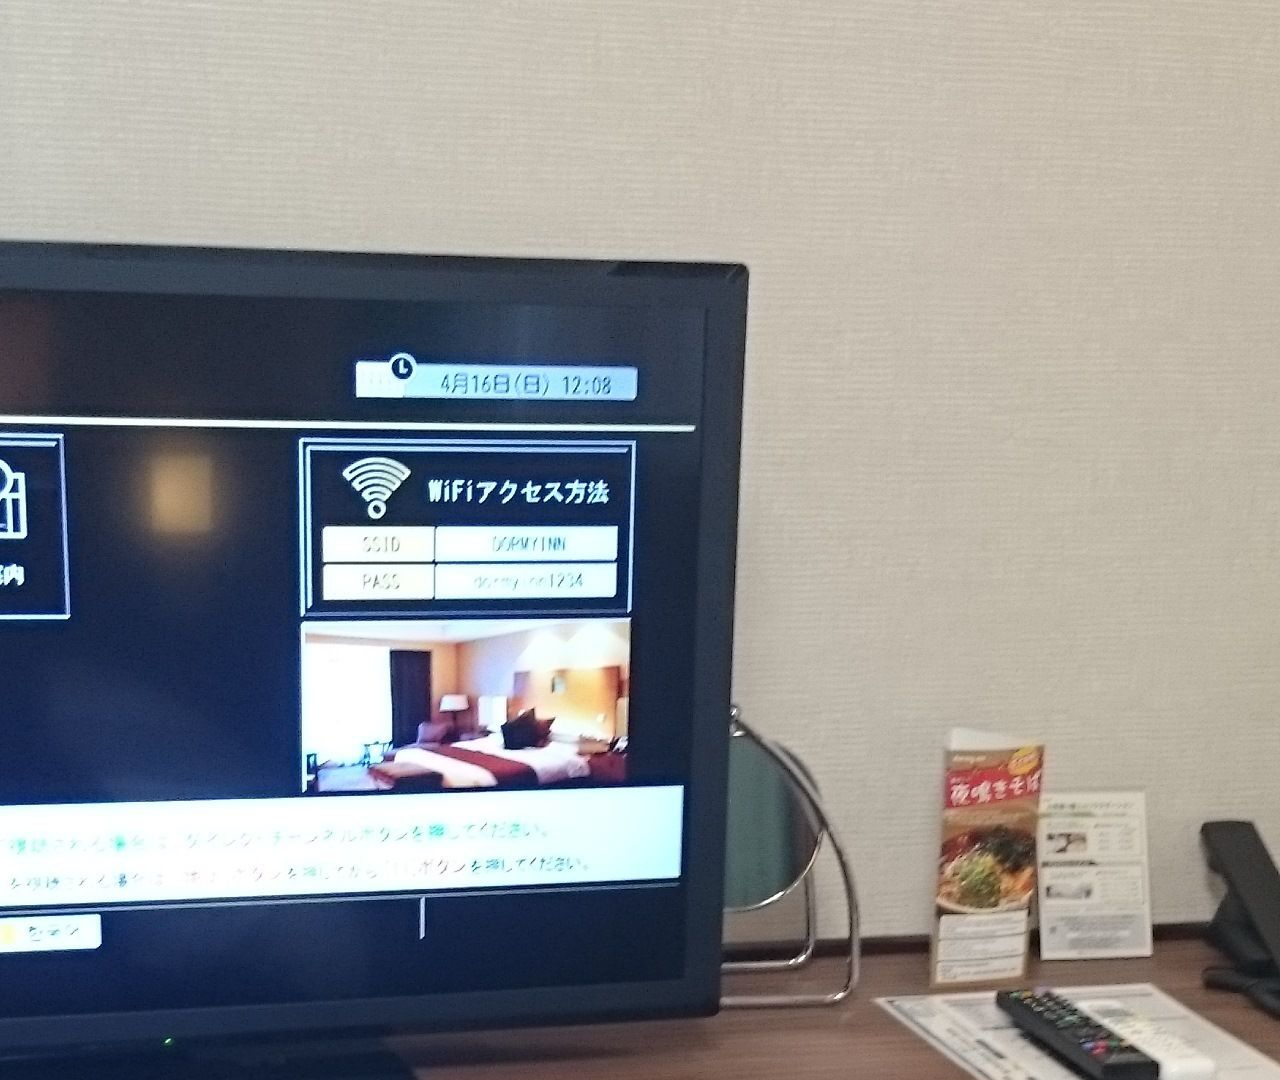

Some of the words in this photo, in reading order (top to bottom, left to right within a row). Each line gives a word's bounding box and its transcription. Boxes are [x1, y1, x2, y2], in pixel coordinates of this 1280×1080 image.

[562, 375, 613, 396] 12:08
[427, 479, 611, 505] WiFiアクセス方法
[362, 535, 401, 553] SSID
[362, 573, 402, 591] PASS
